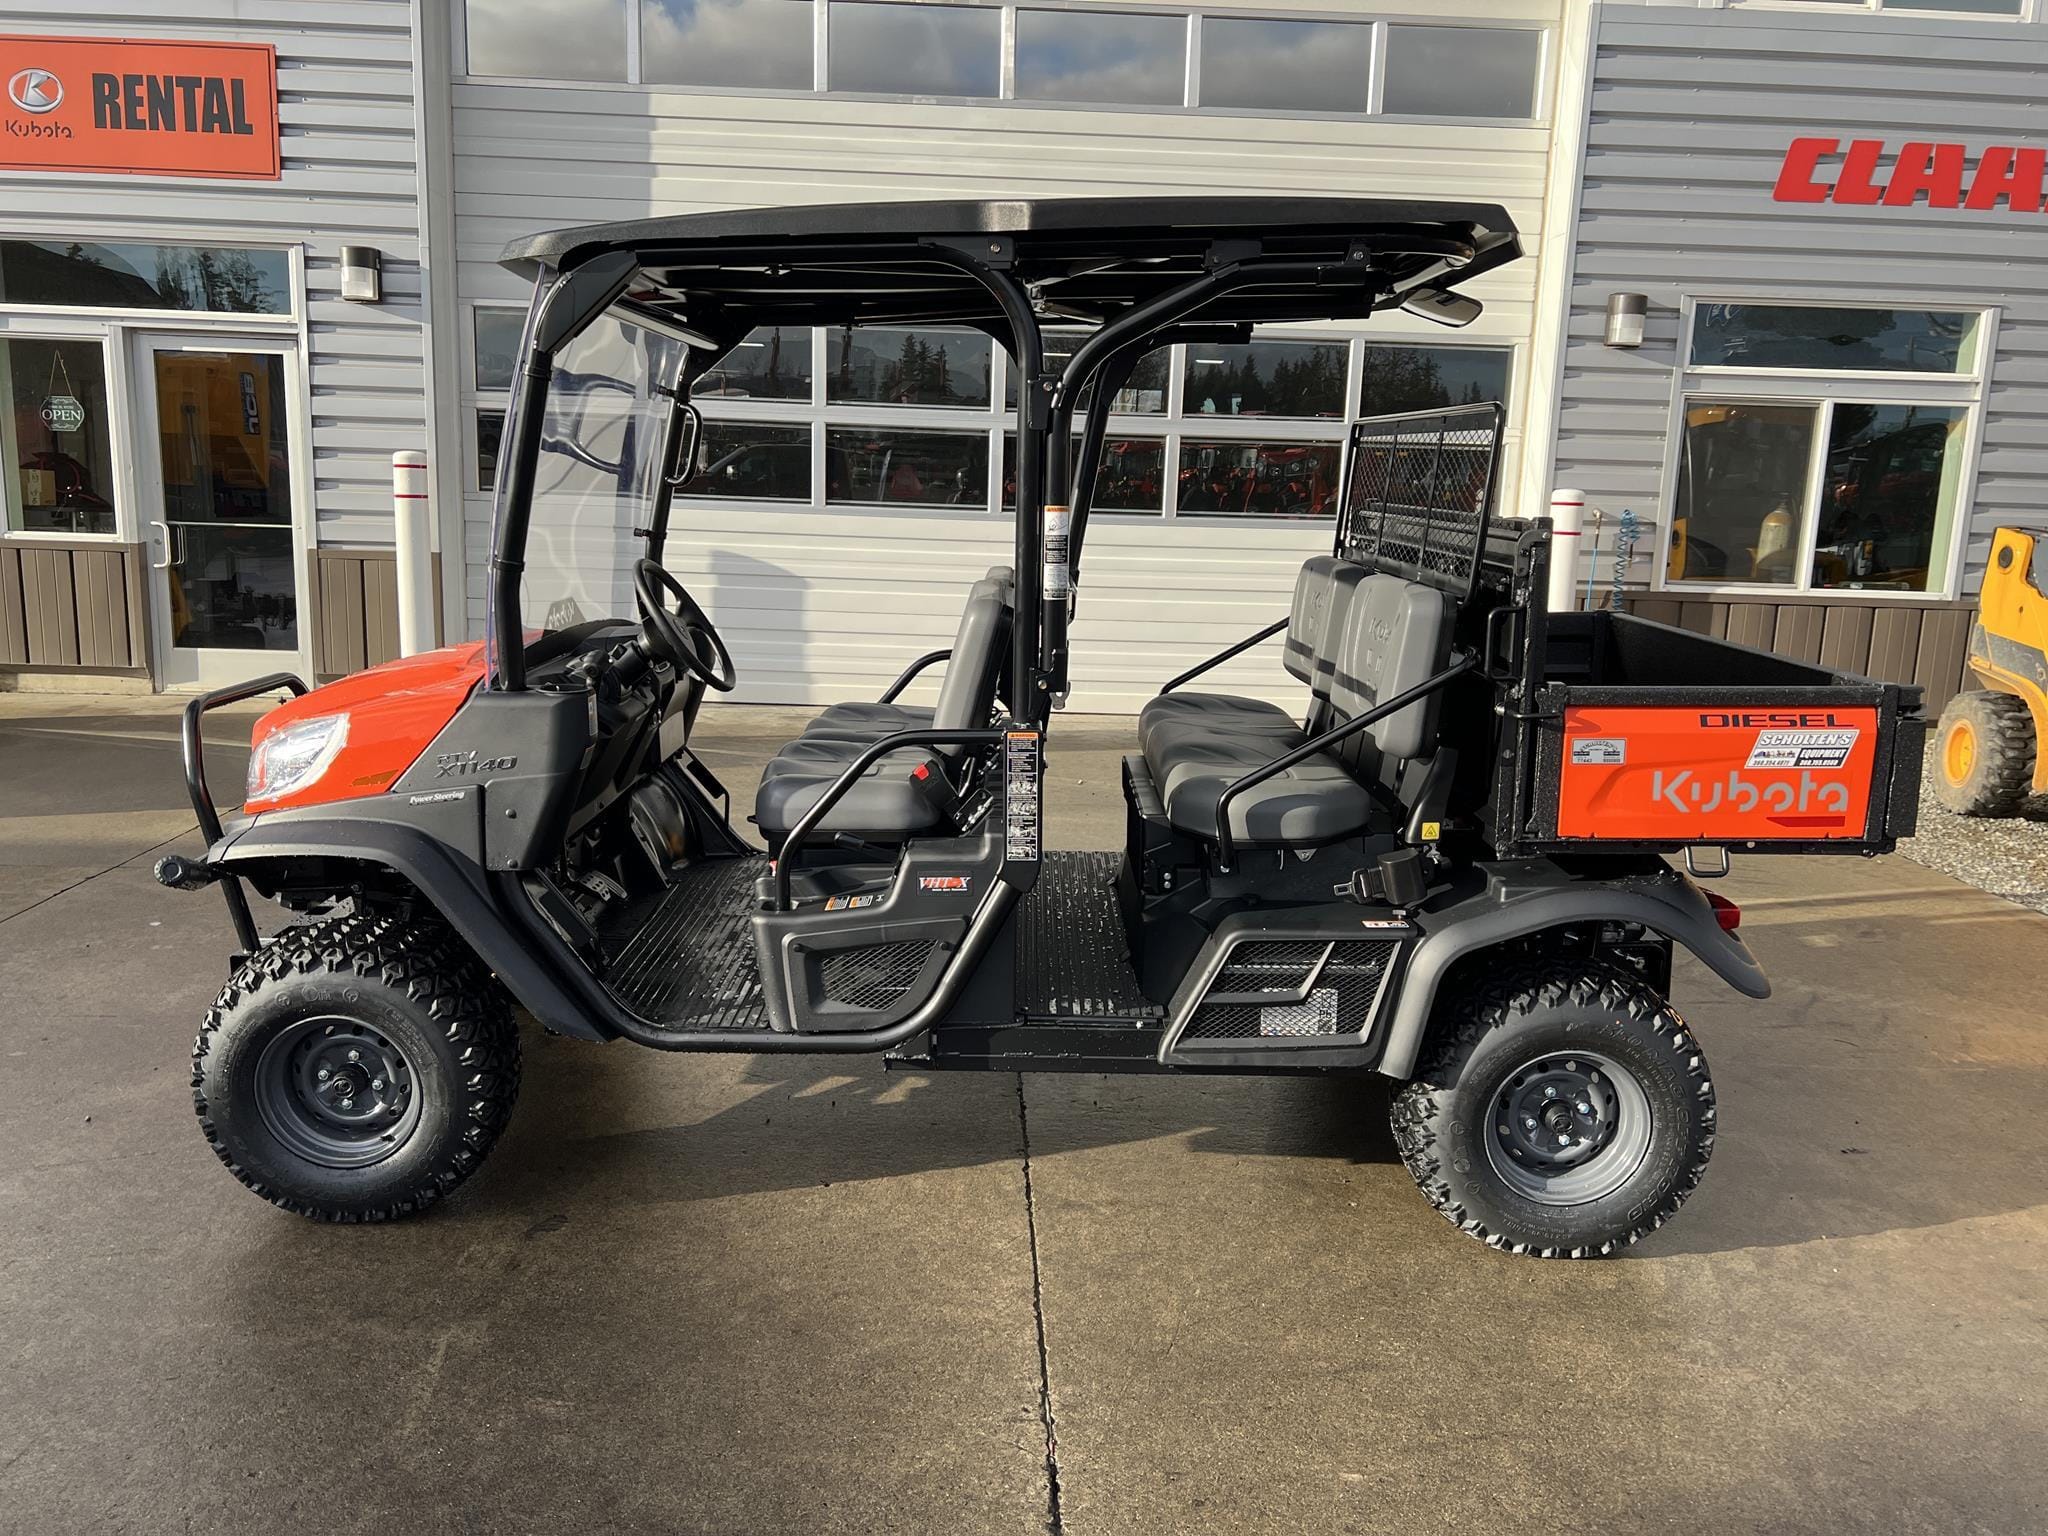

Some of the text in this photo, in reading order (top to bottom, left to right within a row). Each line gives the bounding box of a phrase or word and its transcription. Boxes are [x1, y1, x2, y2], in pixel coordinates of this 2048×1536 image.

[92, 73, 254, 135] RENTAL
[5, 119, 73, 139] Kubota
[1773, 137, 2048, 213] CLAA
[41, 409, 81, 421] OPEN
[1699, 713, 1855, 728] DIESEL
[1760, 733, 1853, 746] SCHOLTEN'S
[437, 750, 478, 764] RTV
[1799, 748, 1847, 759] EQUIPMENT
[409, 790, 466, 805] Power Steering
[1652, 770, 1849, 812] Kubota
